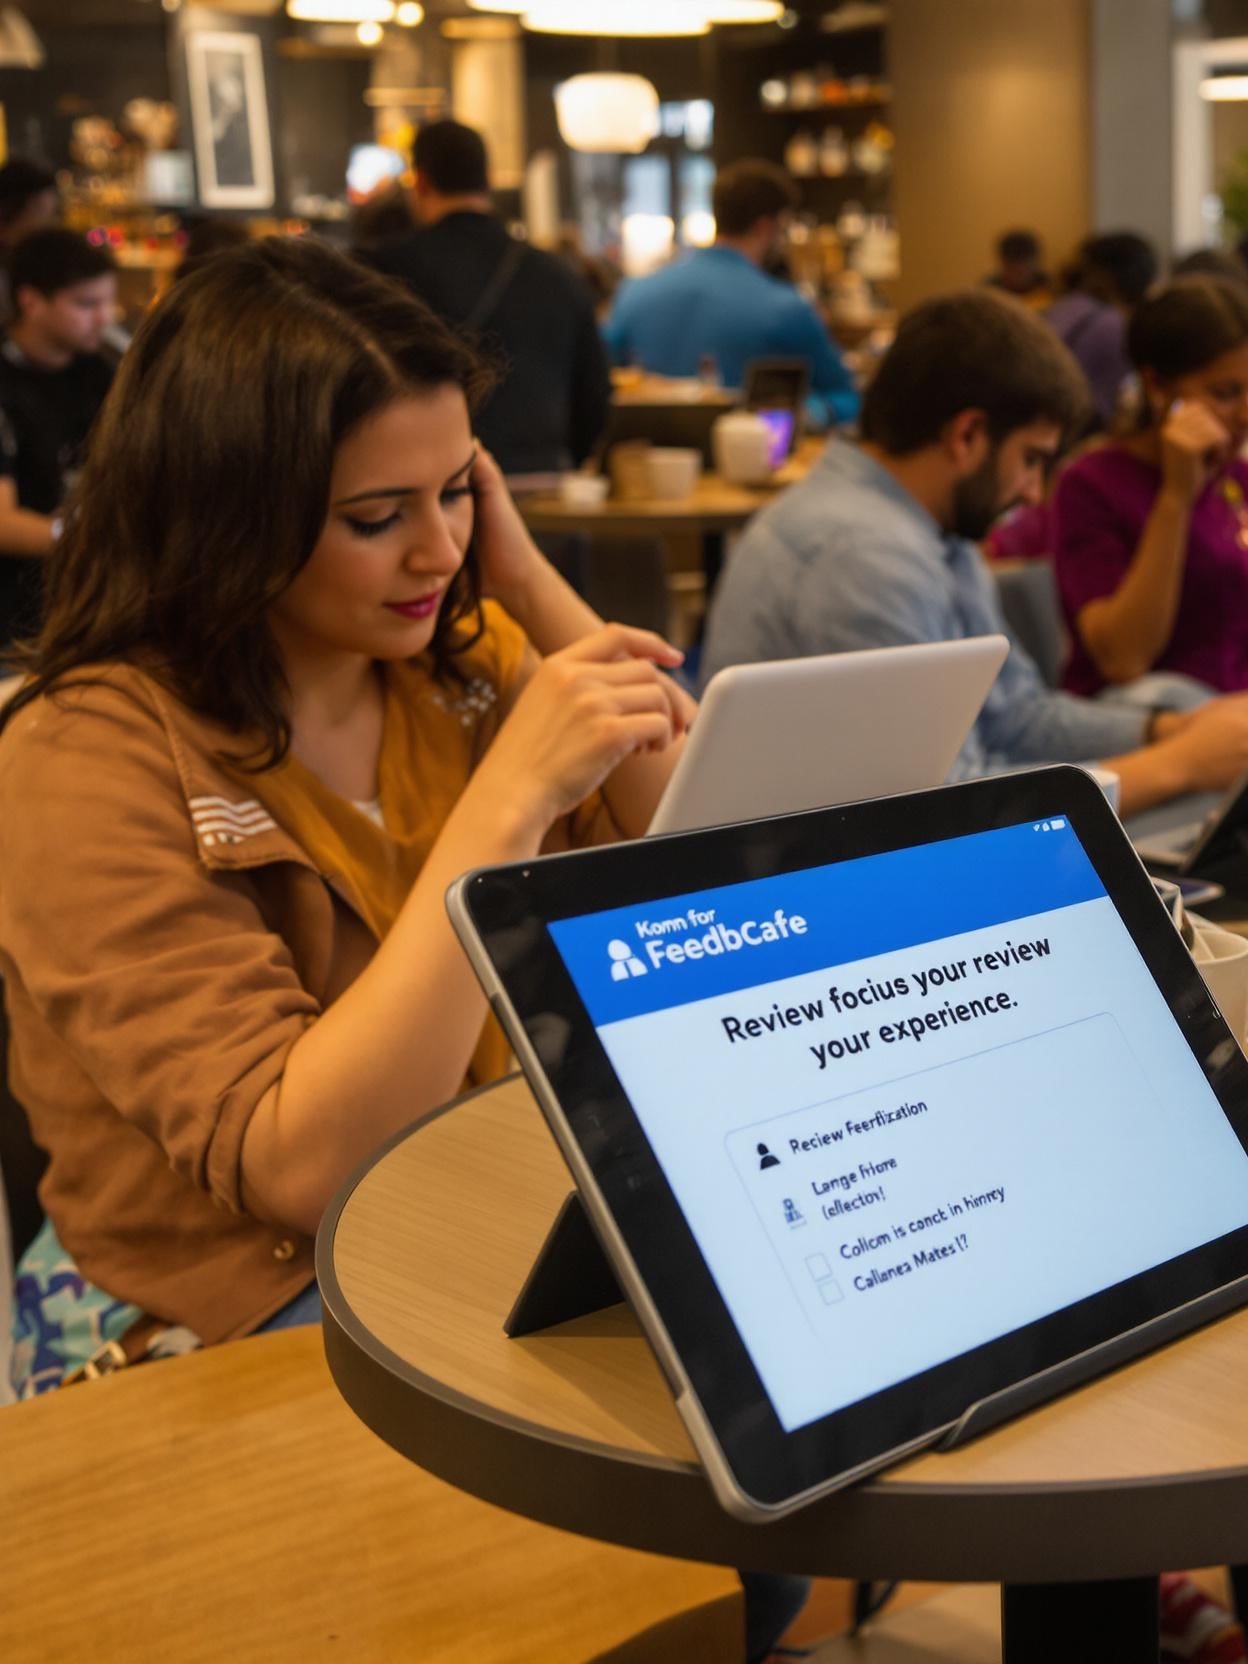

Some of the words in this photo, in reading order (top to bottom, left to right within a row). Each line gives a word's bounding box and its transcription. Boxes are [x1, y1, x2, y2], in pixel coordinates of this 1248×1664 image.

[645, 909, 808, 969] FeedbCafe
[687, 909, 716, 927] for
[721, 998, 824, 1043] Review
[828, 977, 910, 1014] focius
[912, 959, 969, 996] your
[972, 938, 1052, 975] review
[809, 1030, 871, 1070] your
[878, 990, 1019, 1042] experience.
[891, 1225, 907, 1239] is
[947, 1203, 963, 1217] in
